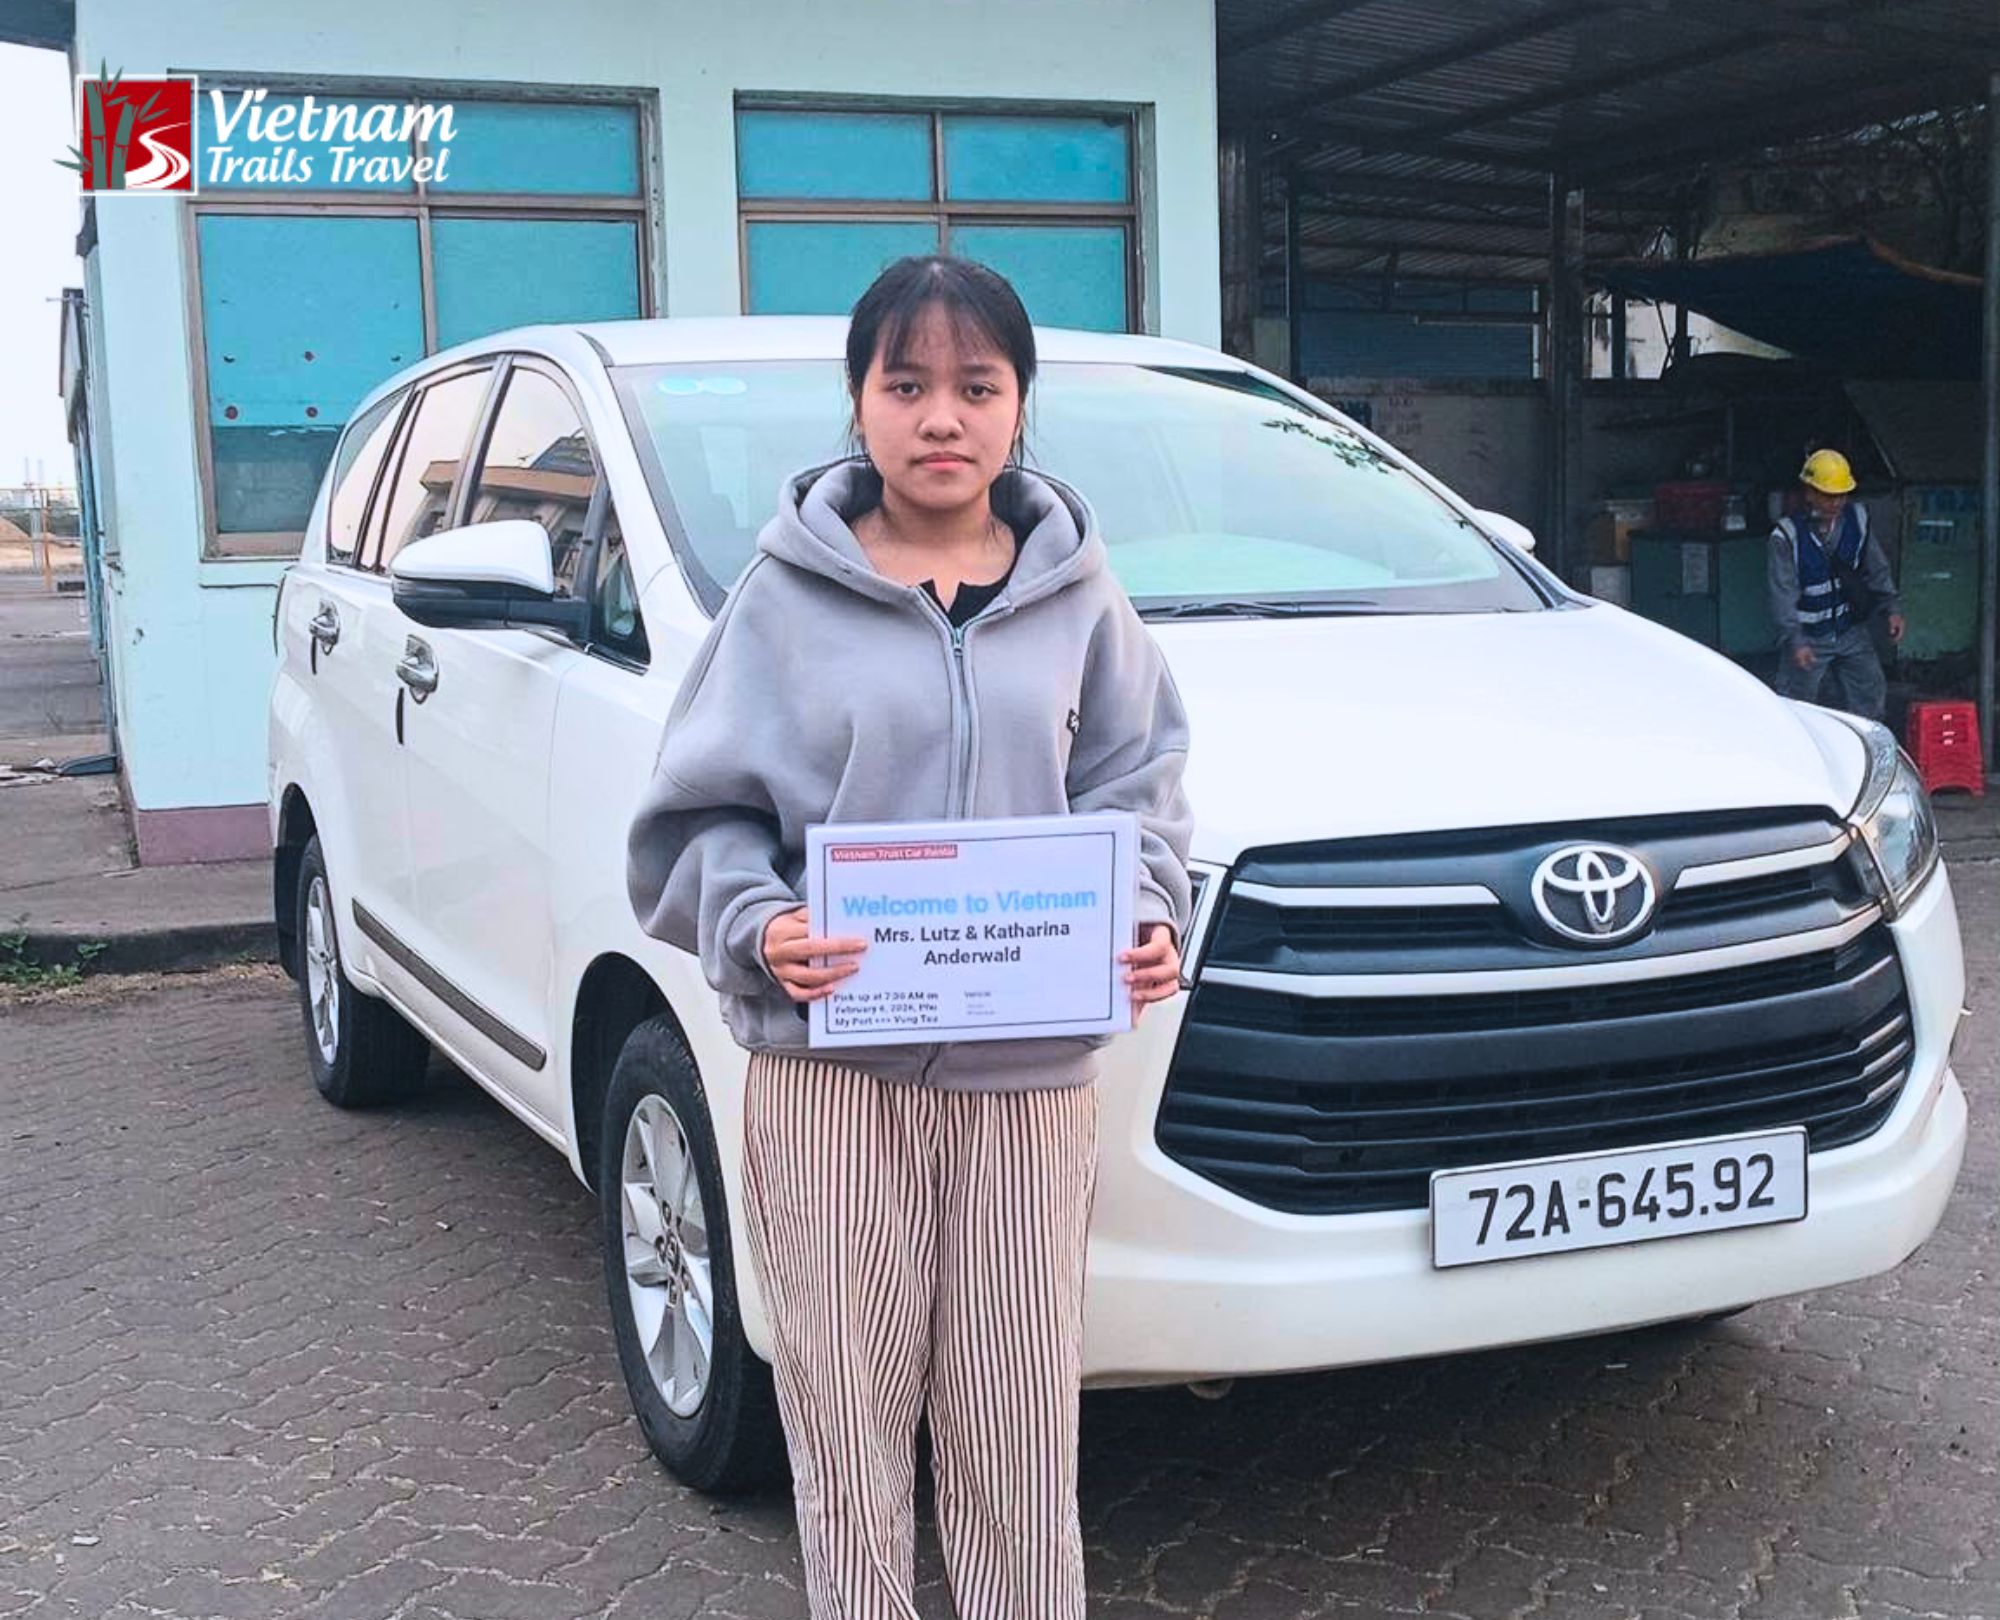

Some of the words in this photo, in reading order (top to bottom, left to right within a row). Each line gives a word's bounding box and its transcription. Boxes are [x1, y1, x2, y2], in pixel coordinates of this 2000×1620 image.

[833, 847, 876, 861] Vietnam
[843, 895, 958, 918] Welcome
[965, 893, 990, 915] to
[997, 889, 1097, 913] Vietnam
[874, 926, 915, 944] Mrs.
[921, 925, 960, 942] Lutz
[965, 924, 978, 941] &
[983, 921, 1071, 940] Katharina
[924, 946, 1021, 966] Anderwald
[908, 991, 924, 1000] AM
[835, 1004, 877, 1015] February
[1467, 1152, 1776, 1247] 72A-645.92
